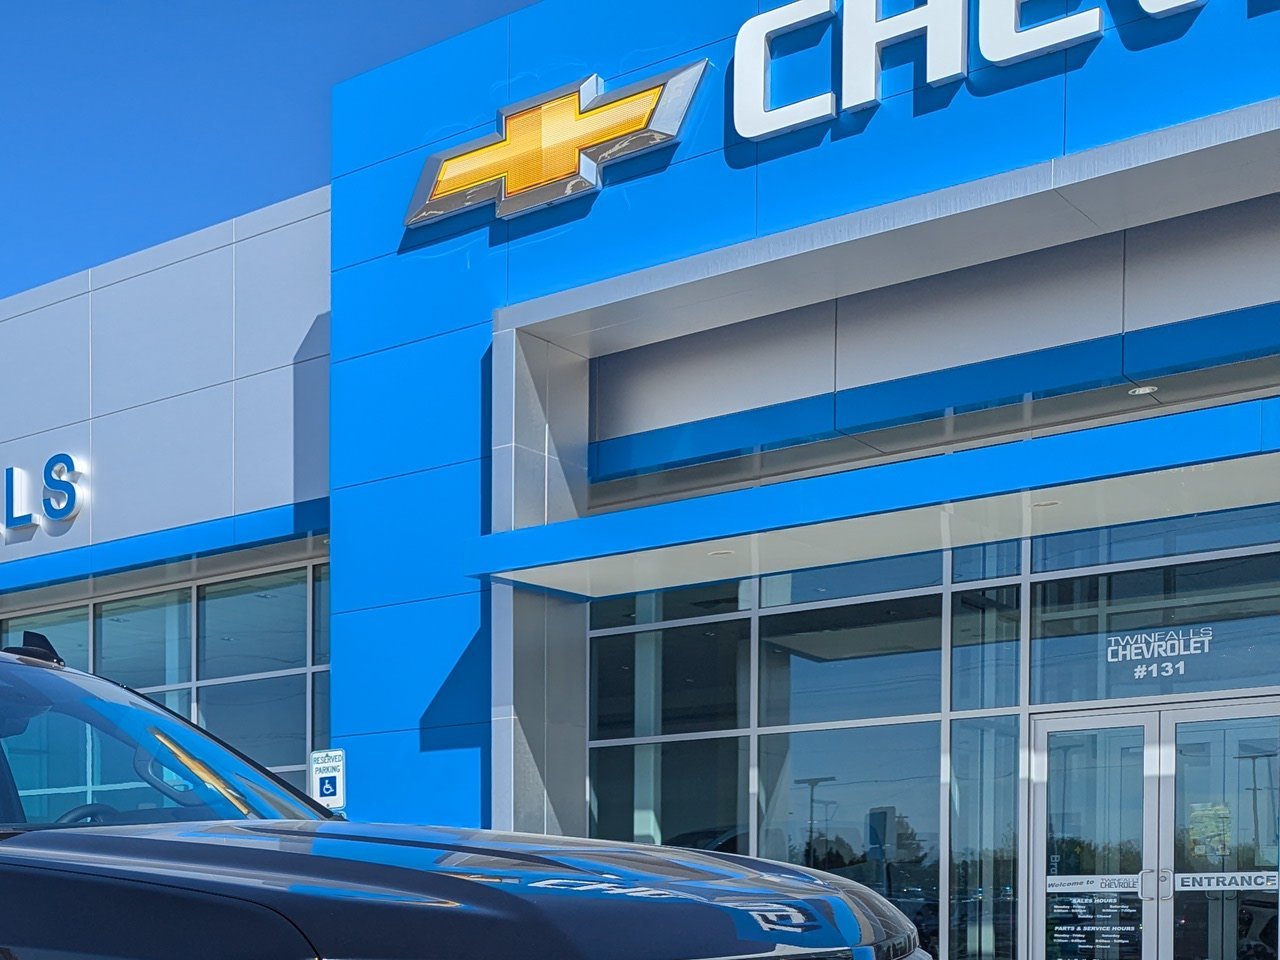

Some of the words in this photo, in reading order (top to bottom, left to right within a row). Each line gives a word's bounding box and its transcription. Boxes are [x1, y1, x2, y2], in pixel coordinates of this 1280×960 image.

[734, 0, 1210, 141] CH
[1107, 627, 1213, 646] TWINFALLS
[1107, 637, 1213, 662] CHEVROLET
[1134, 661, 1185, 679] #131
[313, 755, 342, 764] RESERVED
[315, 765, 341, 775] PARKING
[1180, 875, 1277, 887] ENTRANCE
